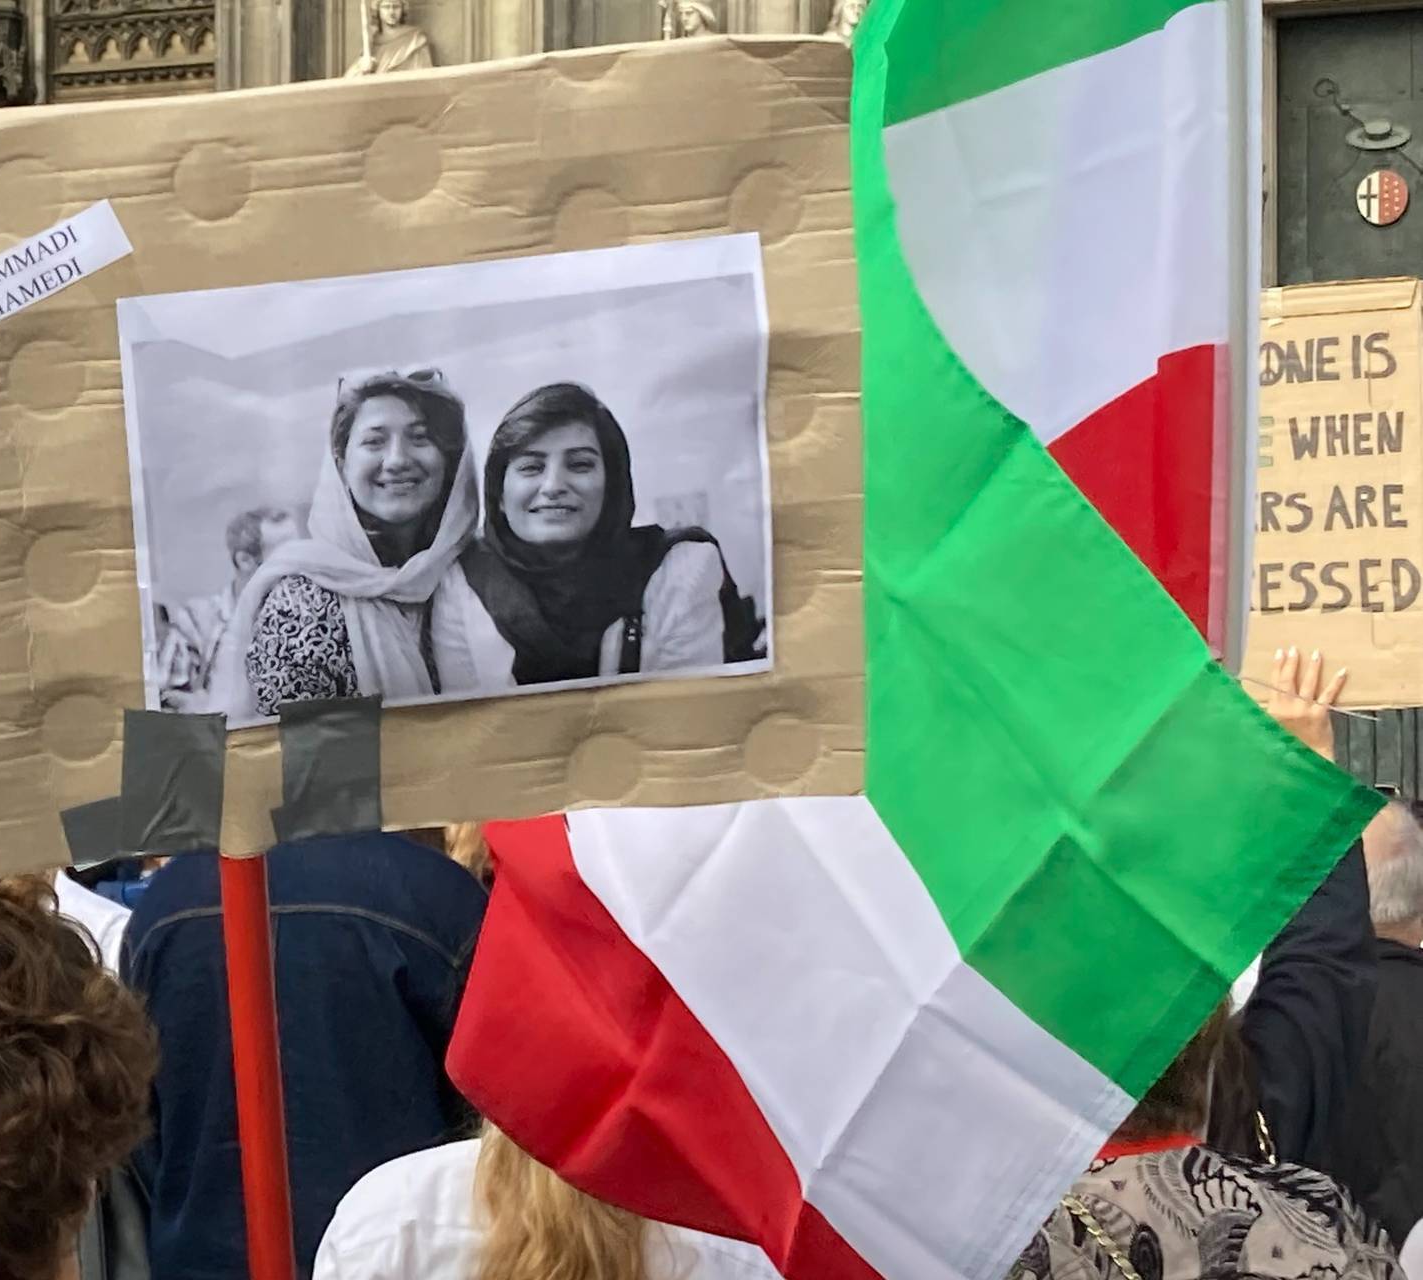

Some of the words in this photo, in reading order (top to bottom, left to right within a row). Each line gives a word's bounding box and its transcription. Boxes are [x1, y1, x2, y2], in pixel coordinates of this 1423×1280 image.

[1352, 332, 1397, 379] IS
[1288, 411, 1404, 460] WHEN
[1324, 483, 1408, 531] ARE
